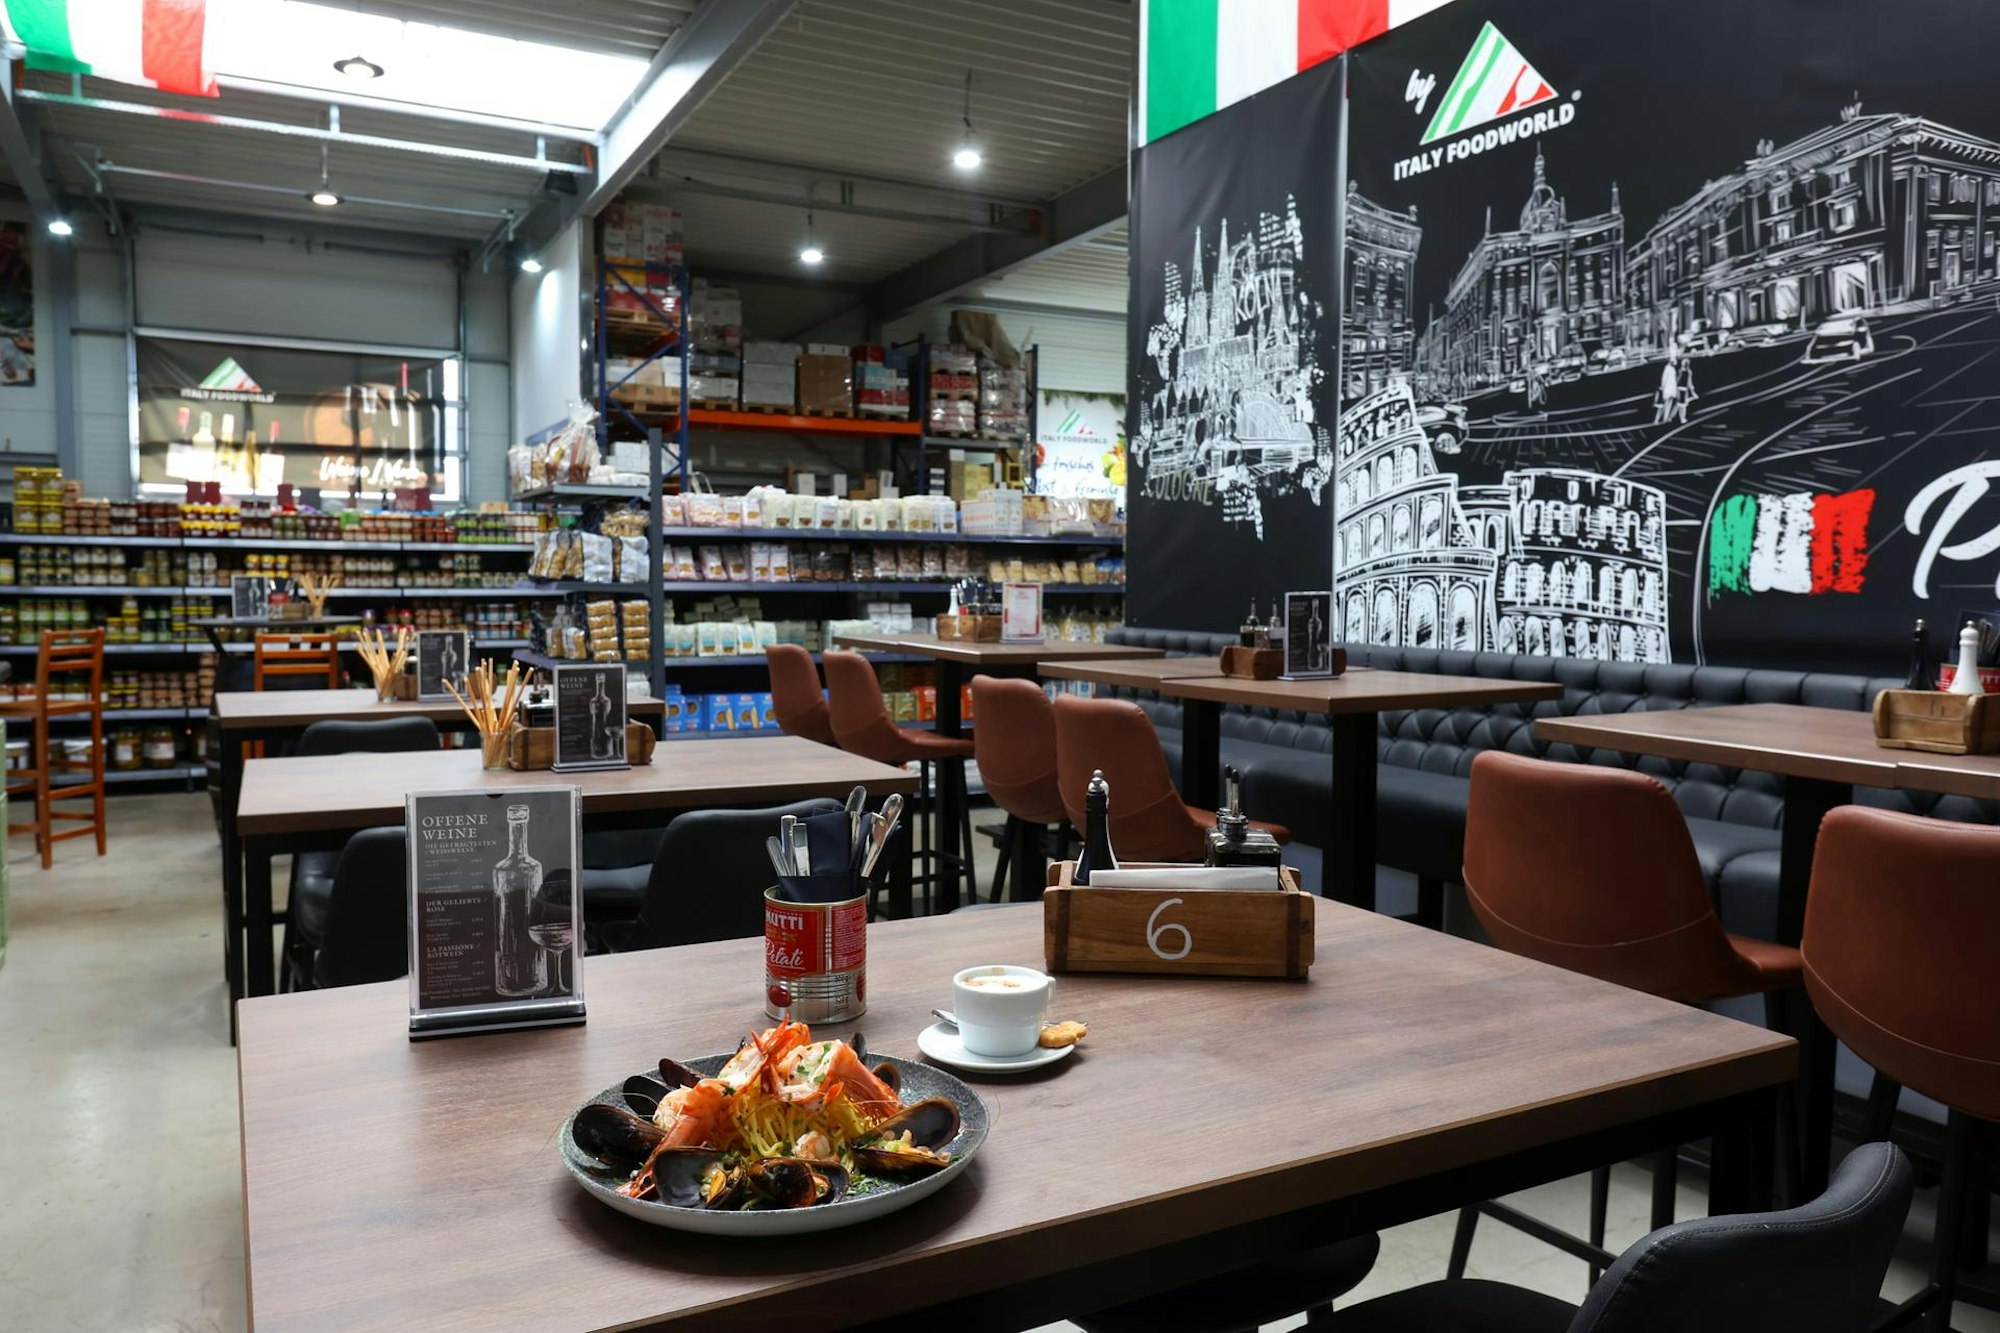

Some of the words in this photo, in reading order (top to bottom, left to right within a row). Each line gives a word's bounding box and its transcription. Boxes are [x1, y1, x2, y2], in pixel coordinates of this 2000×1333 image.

[1405, 68, 1436, 115] by
[1394, 147, 1444, 181] ITALY
[1446, 103, 1575, 164] FOODWORLD
[1041, 434, 1061, 442] ITALY
[422, 814, 488, 828] OFFENE
[422, 828, 477, 840] WEINE
[1146, 898, 1193, 960] 6
